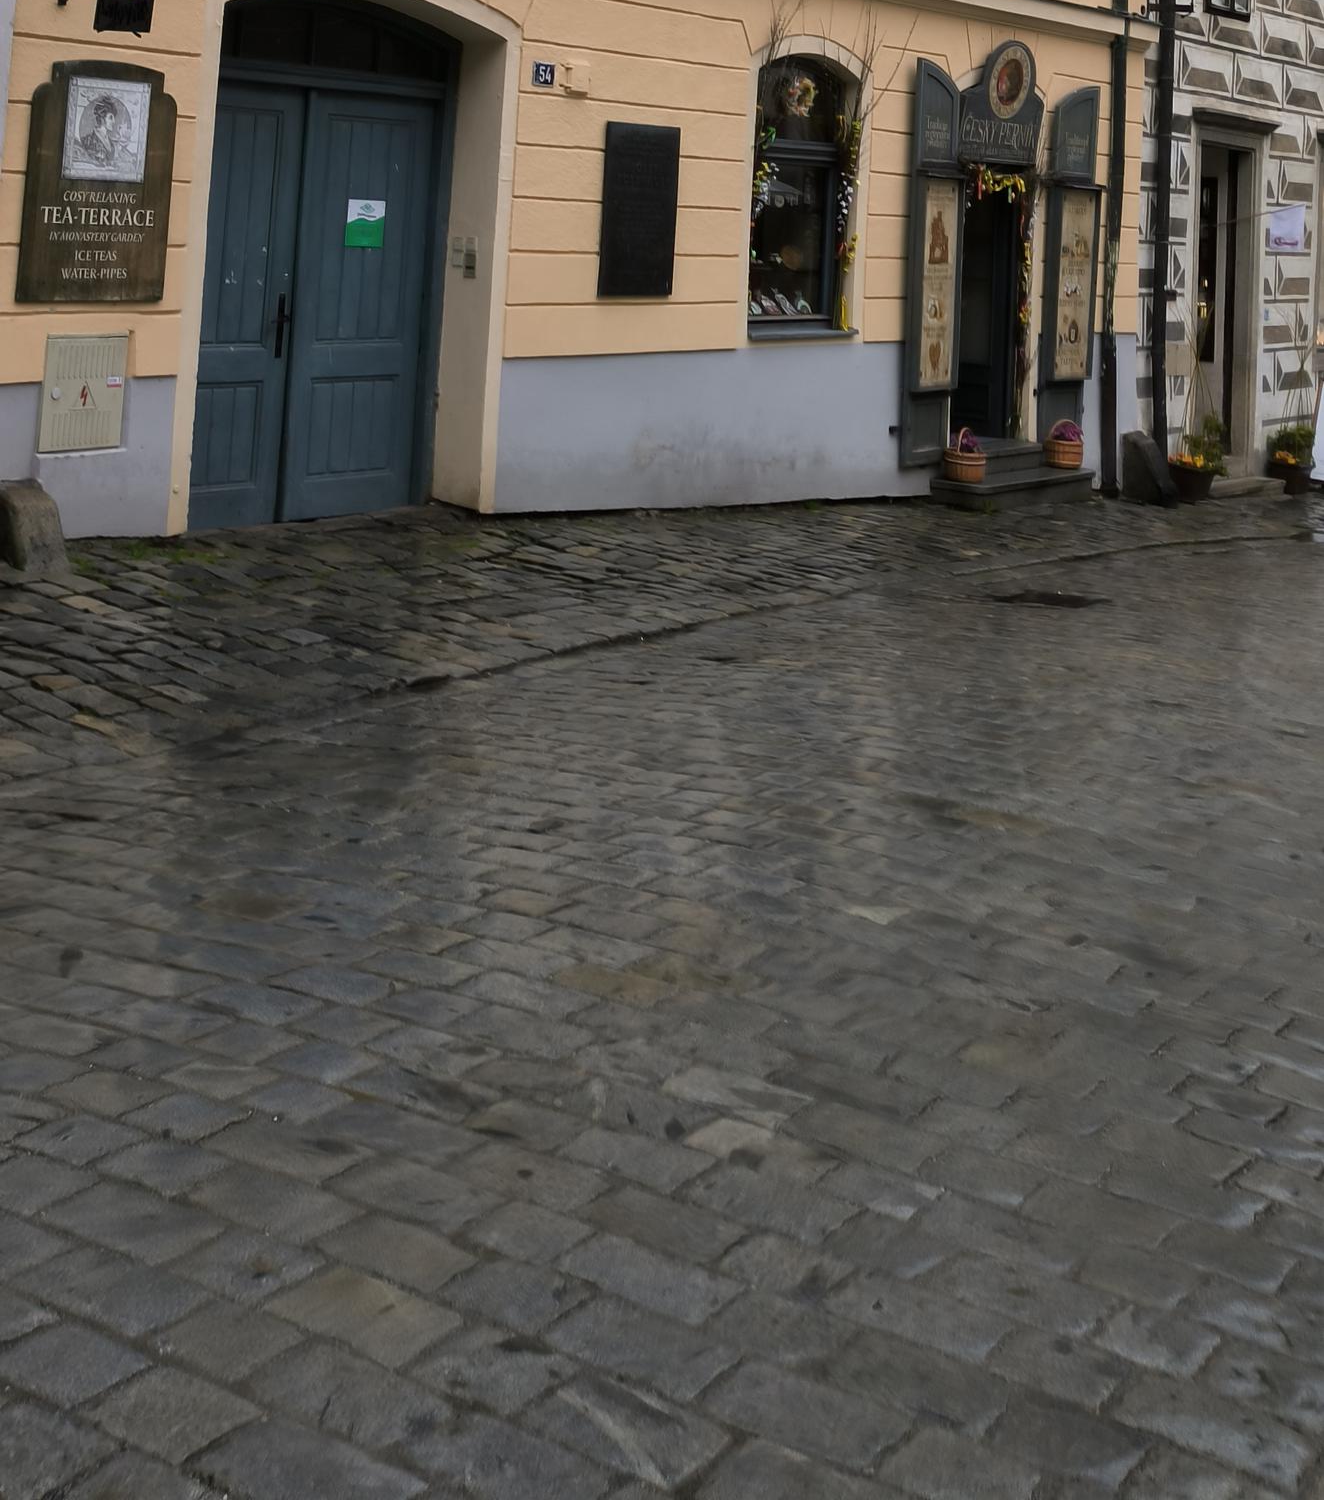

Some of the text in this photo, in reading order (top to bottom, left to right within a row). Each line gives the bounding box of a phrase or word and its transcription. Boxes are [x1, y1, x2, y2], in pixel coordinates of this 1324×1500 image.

[539, 65, 552, 84] 54
[63, 190, 137, 204] COSY RELAXING
[40, 205, 155, 227] TEA-TERRACE
[49, 231, 145, 243] IN MONASTERY GARDEN
[74, 249, 117, 262] ICE TEAS
[61, 267, 127, 280] WATER-PIPES
